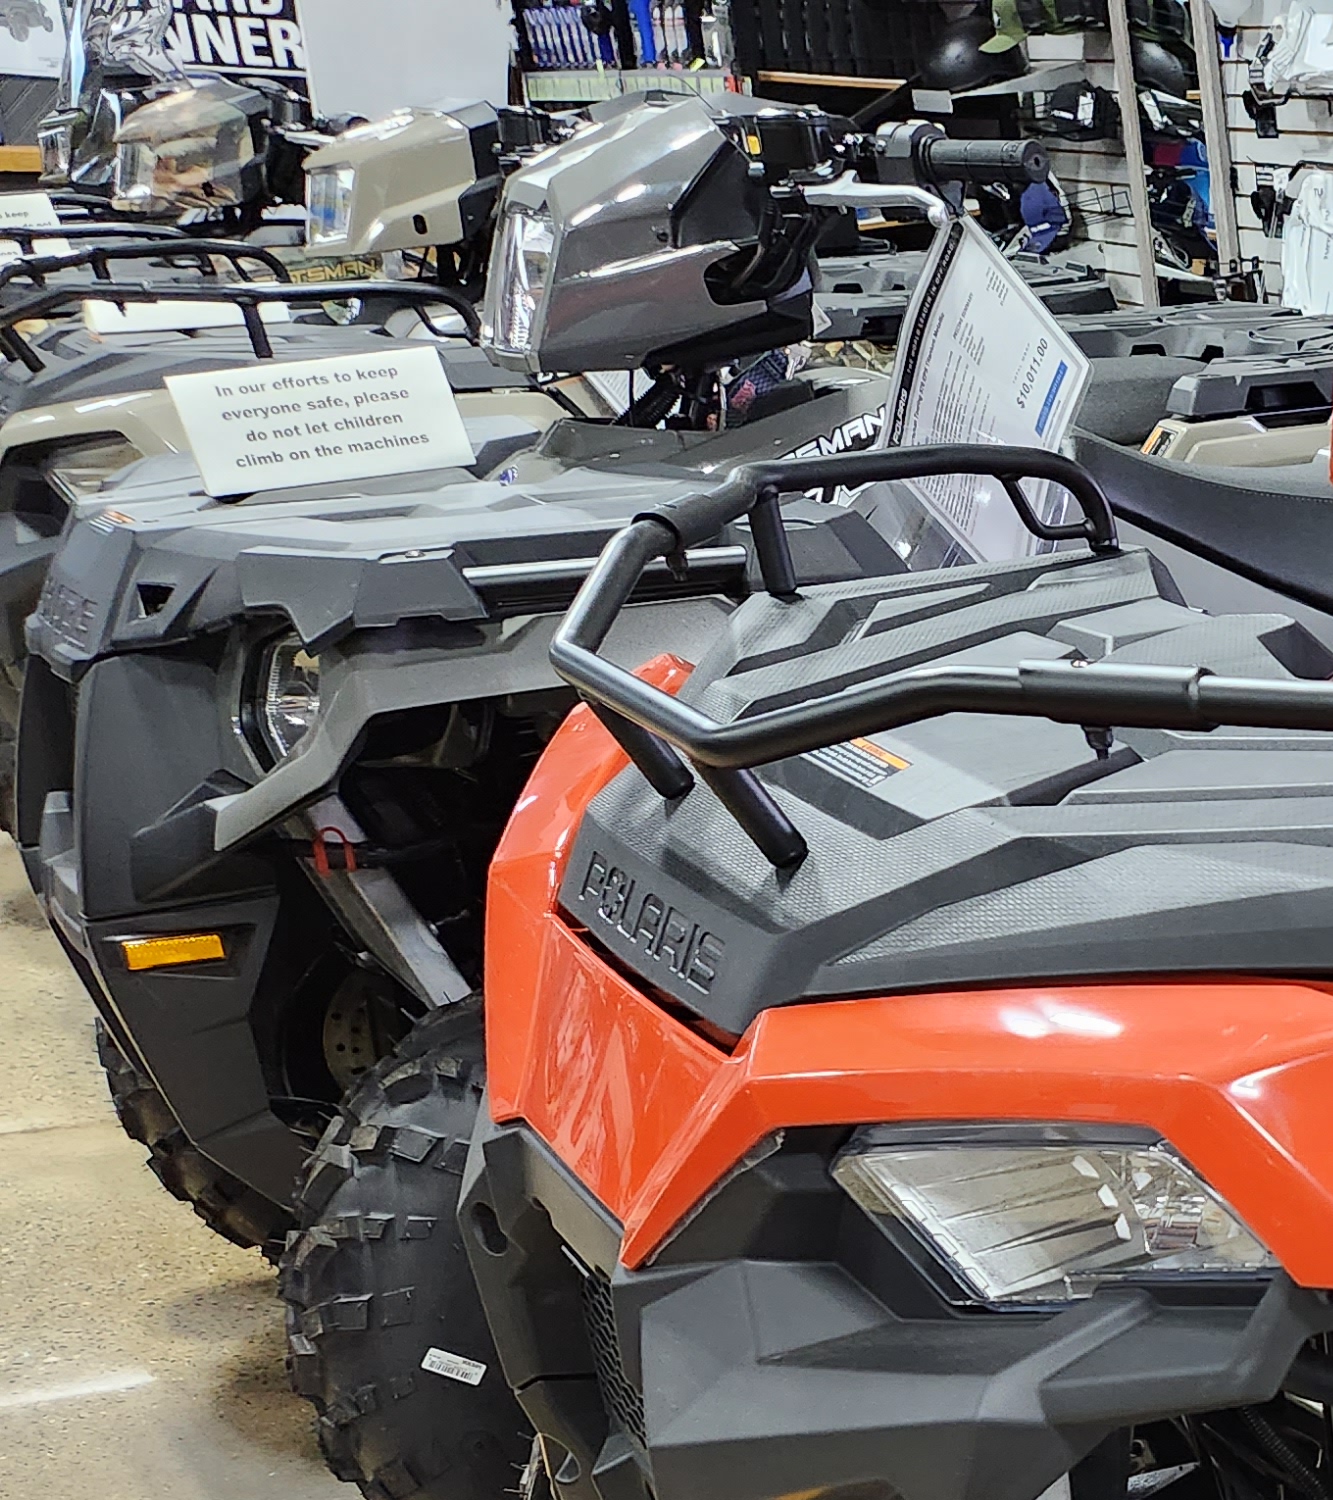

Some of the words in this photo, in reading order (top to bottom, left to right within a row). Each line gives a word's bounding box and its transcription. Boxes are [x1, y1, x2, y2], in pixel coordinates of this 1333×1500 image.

[166, 13, 305, 68] NNER
[215, 385, 233, 398] In
[238, 382, 267, 396] our
[272, 374, 330, 391] efforts
[333, 371, 351, 383] to
[355, 365, 399, 381] keep
[893, 388, 907, 445] POLARIS
[917, 295, 932, 329] LEADER
[1016, 338, 1048, 409] $10,011.00
[221, 402, 302, 421] everyone
[306, 396, 350, 411] safe,
[353, 387, 410, 406] please
[235, 451, 284, 468] climb
[289, 448, 311, 462] on
[314, 442, 343, 457] the
[348, 431, 430, 453] machines
[246, 429, 268, 443] do
[272, 425, 302, 439] not
[305, 420, 329, 435] let
[333, 412, 403, 431] children
[578, 850, 726, 995] POLARIS
